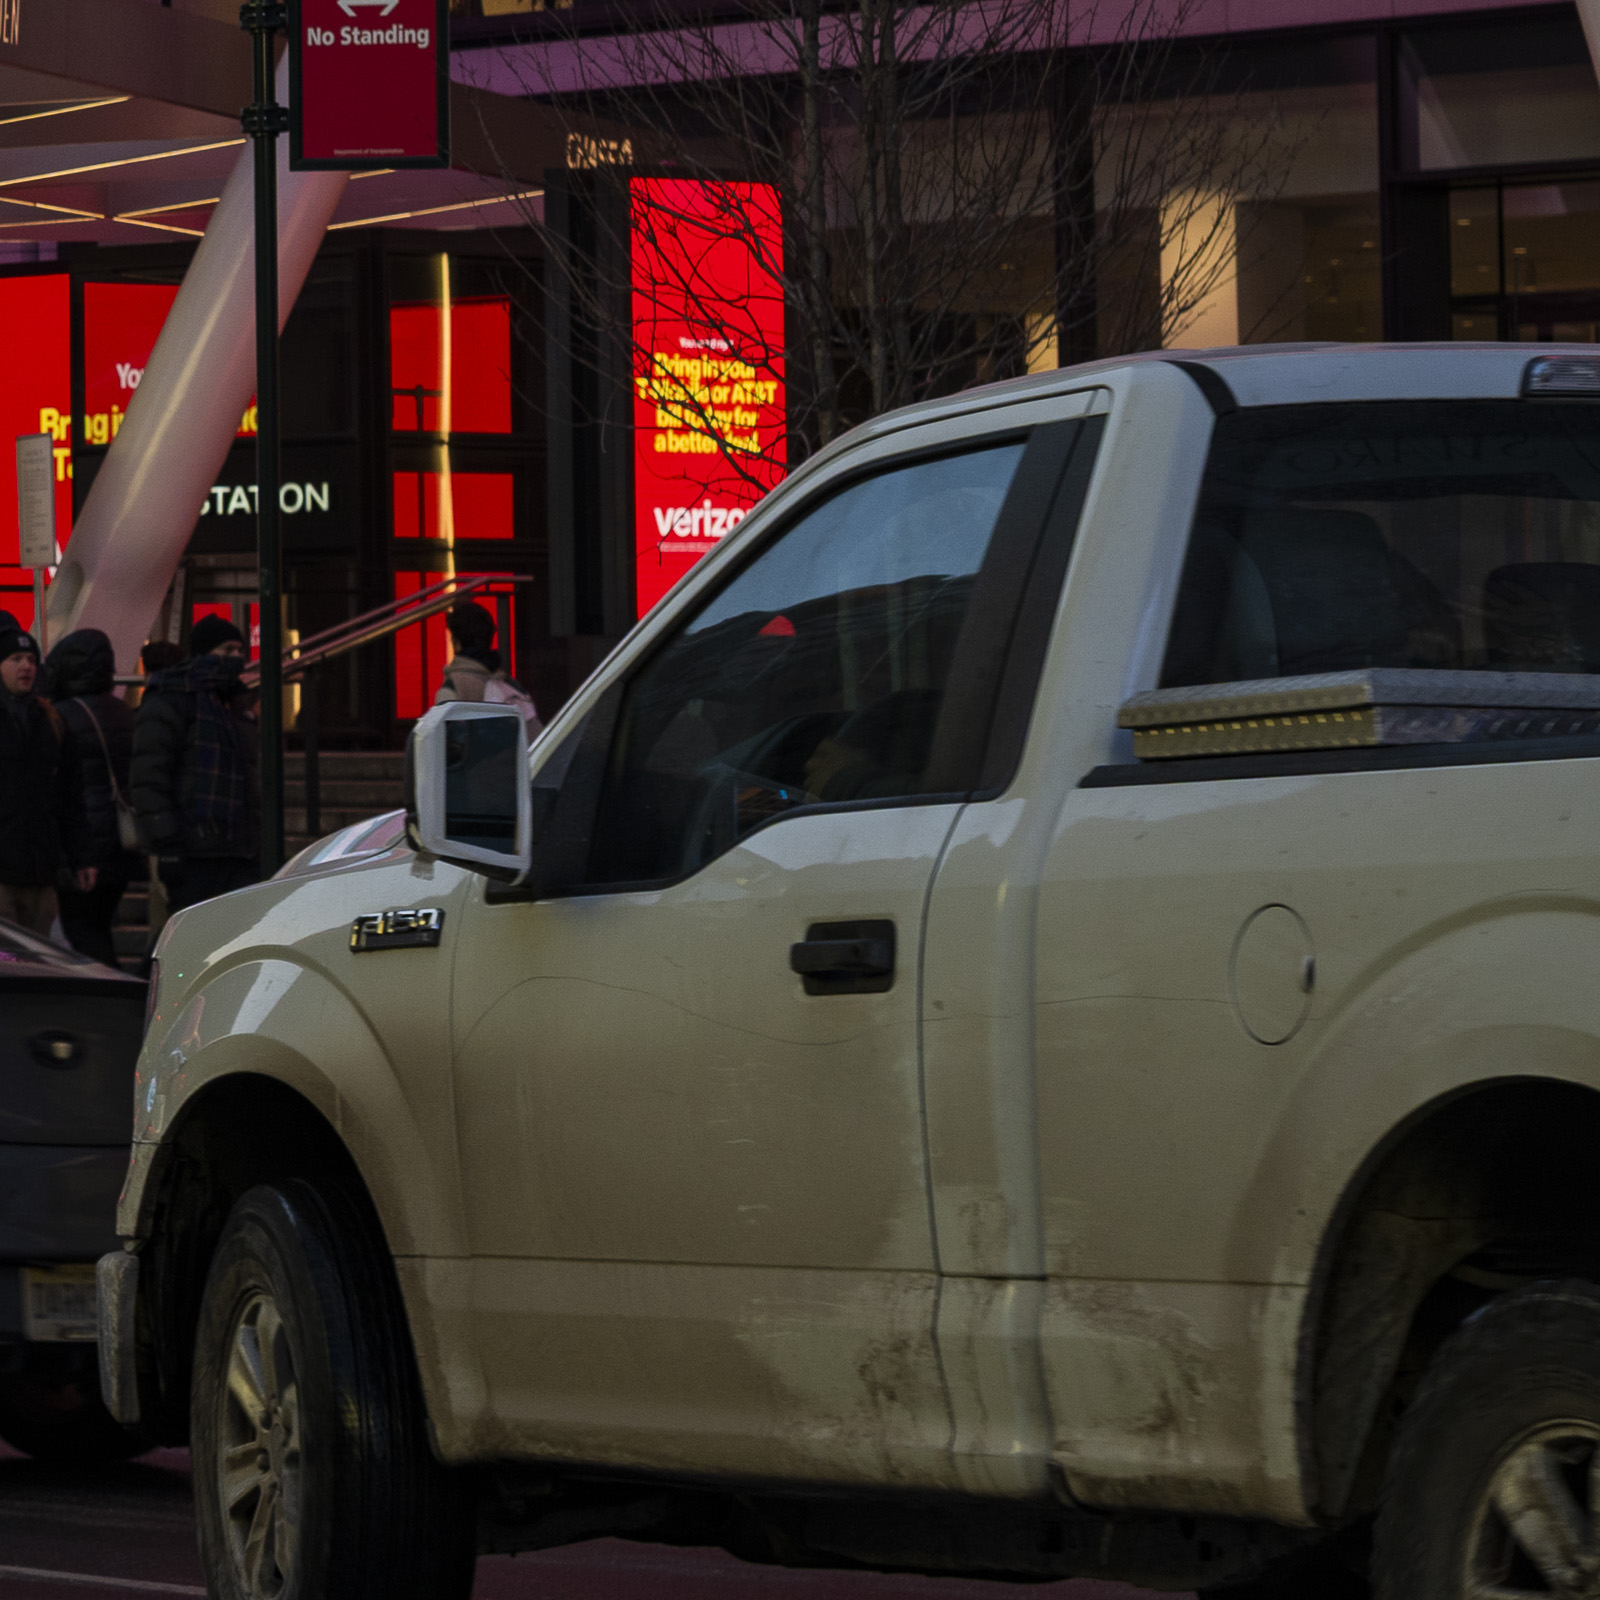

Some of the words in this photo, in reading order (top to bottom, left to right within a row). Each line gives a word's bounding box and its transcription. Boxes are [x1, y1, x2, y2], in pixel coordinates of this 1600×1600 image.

[307, 26, 335, 47] No
[340, 23, 430, 49] Standing
[654, 353, 701, 379] Bring
[722, 361, 756, 380] your
[731, 381, 778, 405] AT&T
[654, 436, 666, 453] a
[200, 482, 329, 516] TATON
[654, 499, 752, 537] verizo
